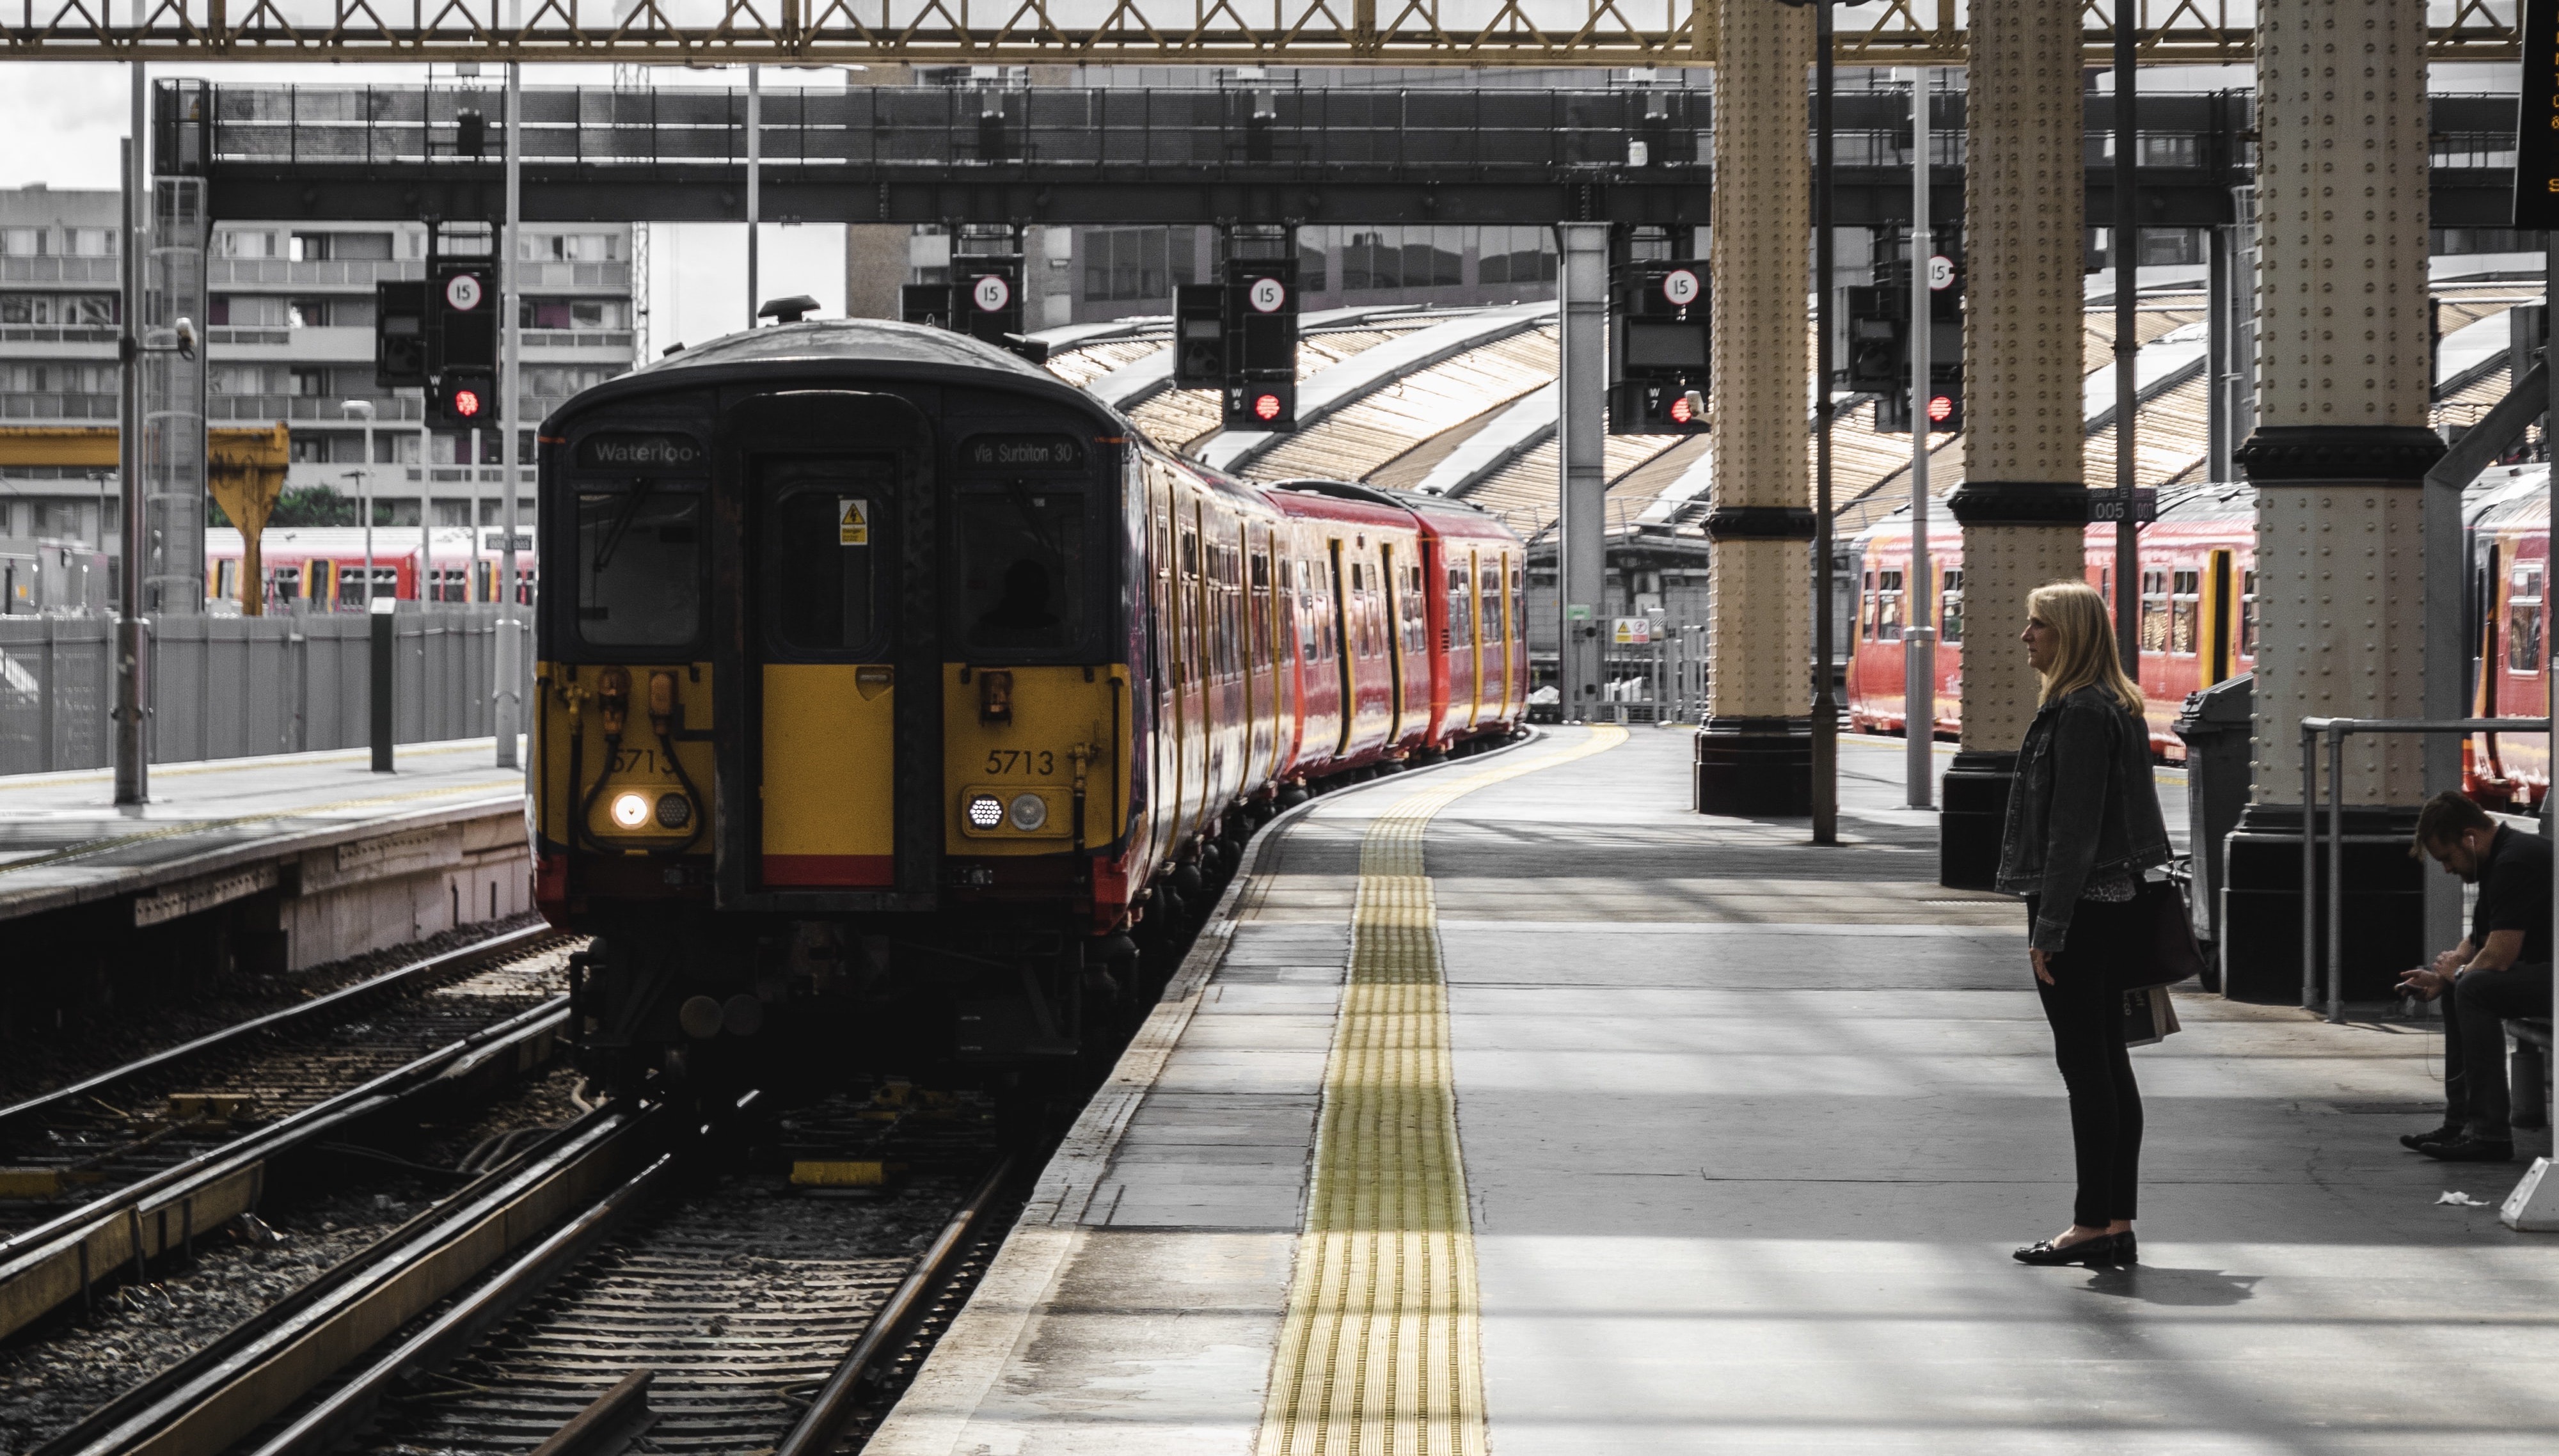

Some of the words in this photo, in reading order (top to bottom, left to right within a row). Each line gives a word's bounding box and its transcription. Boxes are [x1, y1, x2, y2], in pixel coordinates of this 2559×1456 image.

[1931, 265, 1945, 280] 15
[456, 285, 471, 301] 15
[985, 286, 998, 301] 15
[1674, 280, 1689, 295] 15
[1260, 288, 1274, 303] 15
[429, 375, 441, 386] W
[1231, 388, 1243, 398] W
[1648, 388, 1661, 397] W
[1650, 400, 1659, 409] 7
[596, 442, 693, 461] Waterloo
[999, 443, 1049, 462] Surbiton
[1056, 443, 1072, 462] 30
[2096, 502, 2125, 519] 005
[986, 750, 1054, 775] 5713
